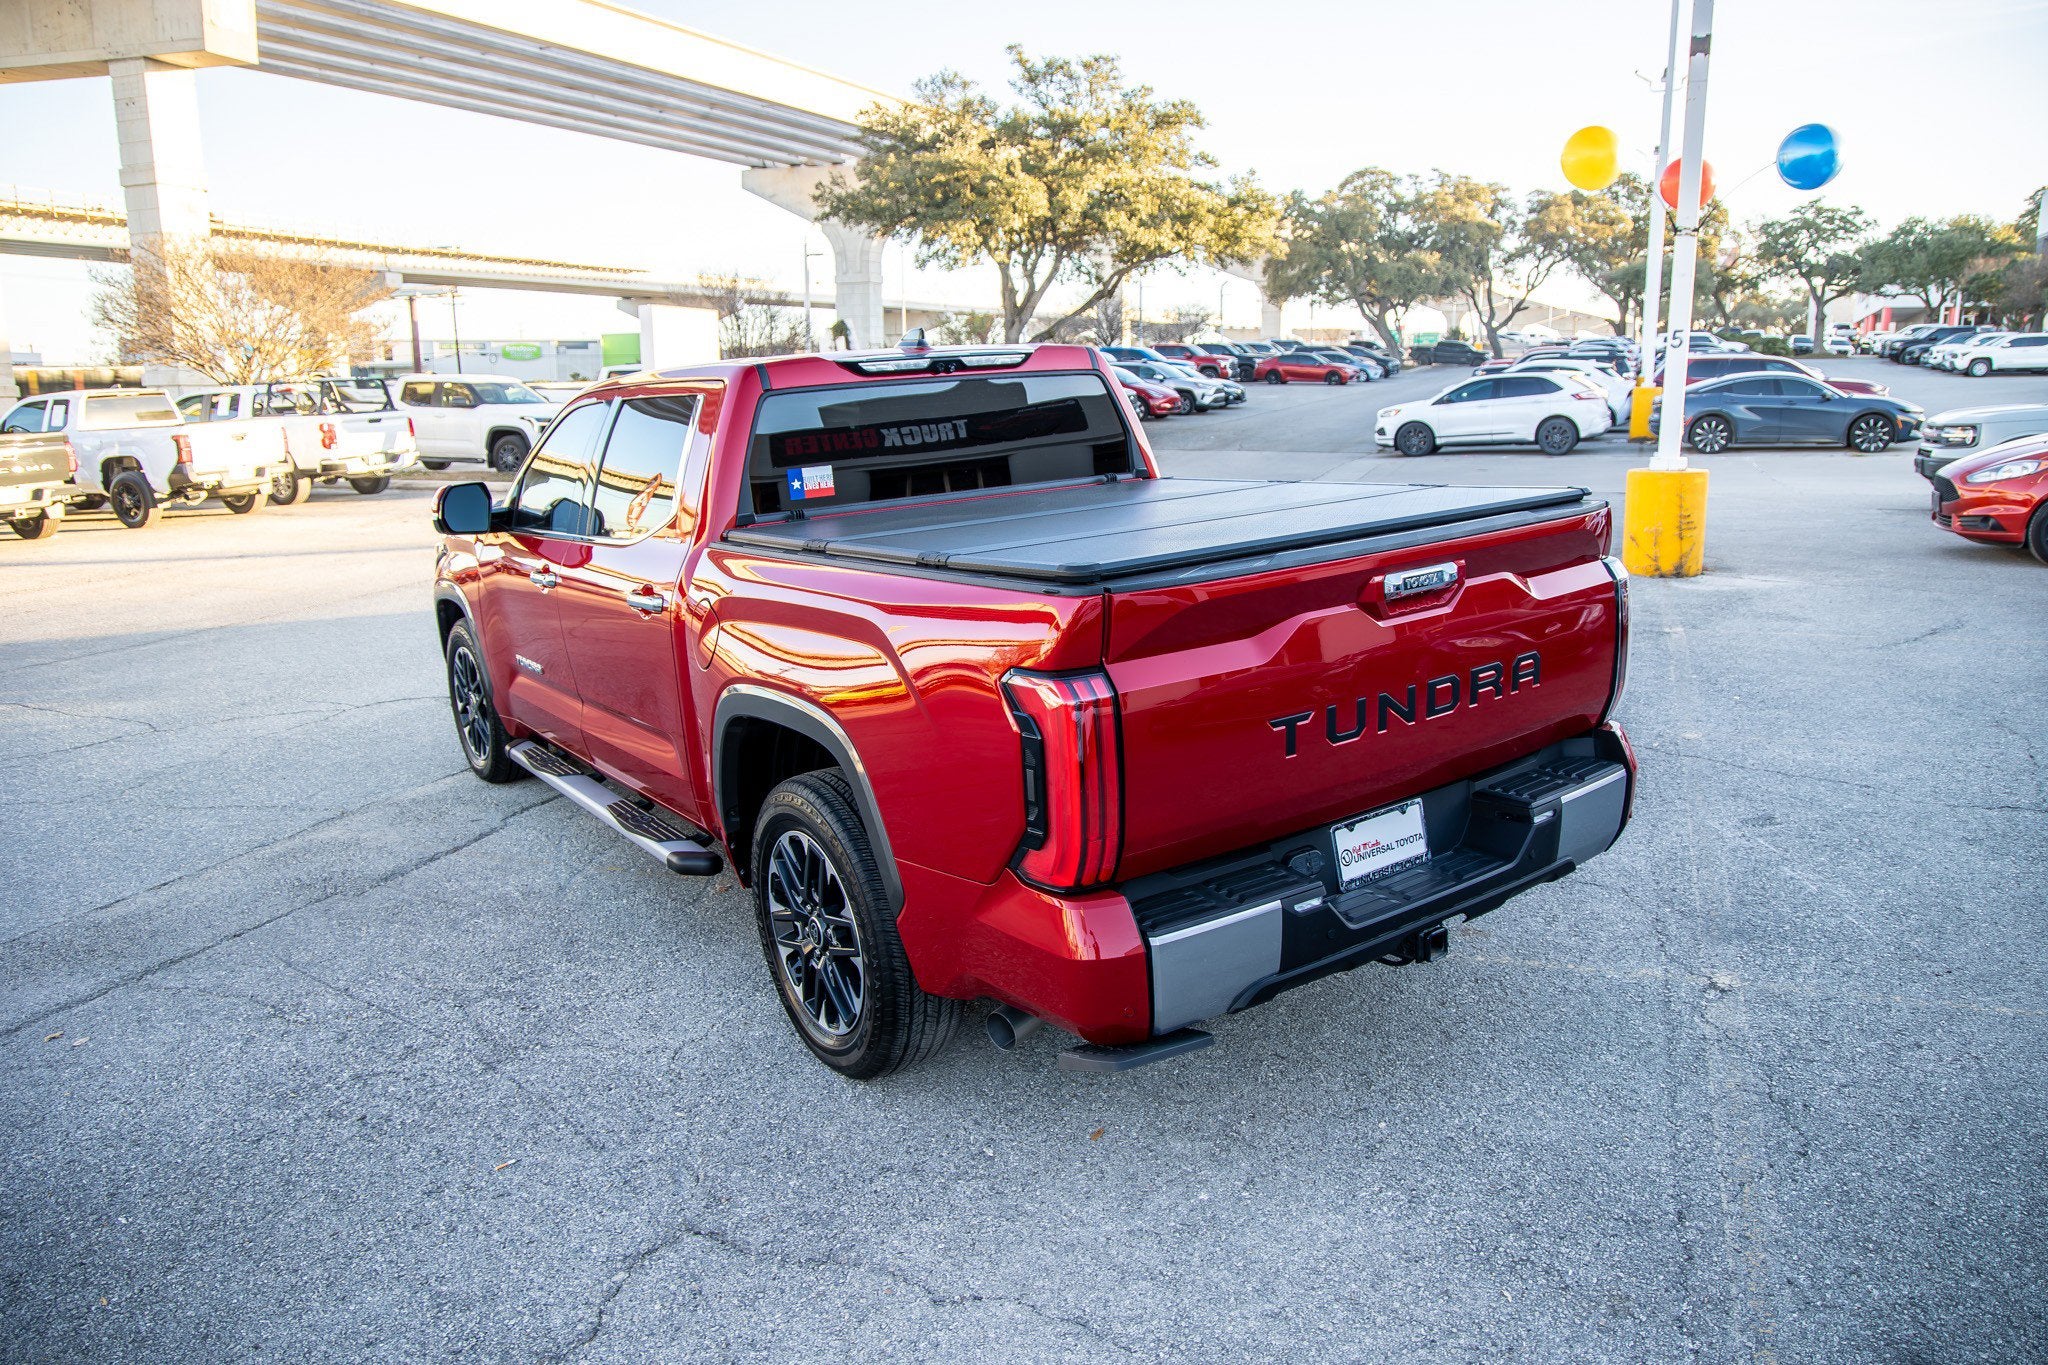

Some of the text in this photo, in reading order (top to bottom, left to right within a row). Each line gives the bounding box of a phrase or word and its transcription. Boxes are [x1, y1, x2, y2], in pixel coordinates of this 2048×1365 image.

[1671, 329, 1684, 349] 5
[1405, 572, 1438, 589] TOYOTA
[1267, 650, 1542, 759] TUNDRA
[1353, 833, 1424, 863] UNIVERSAL TOYOTA
